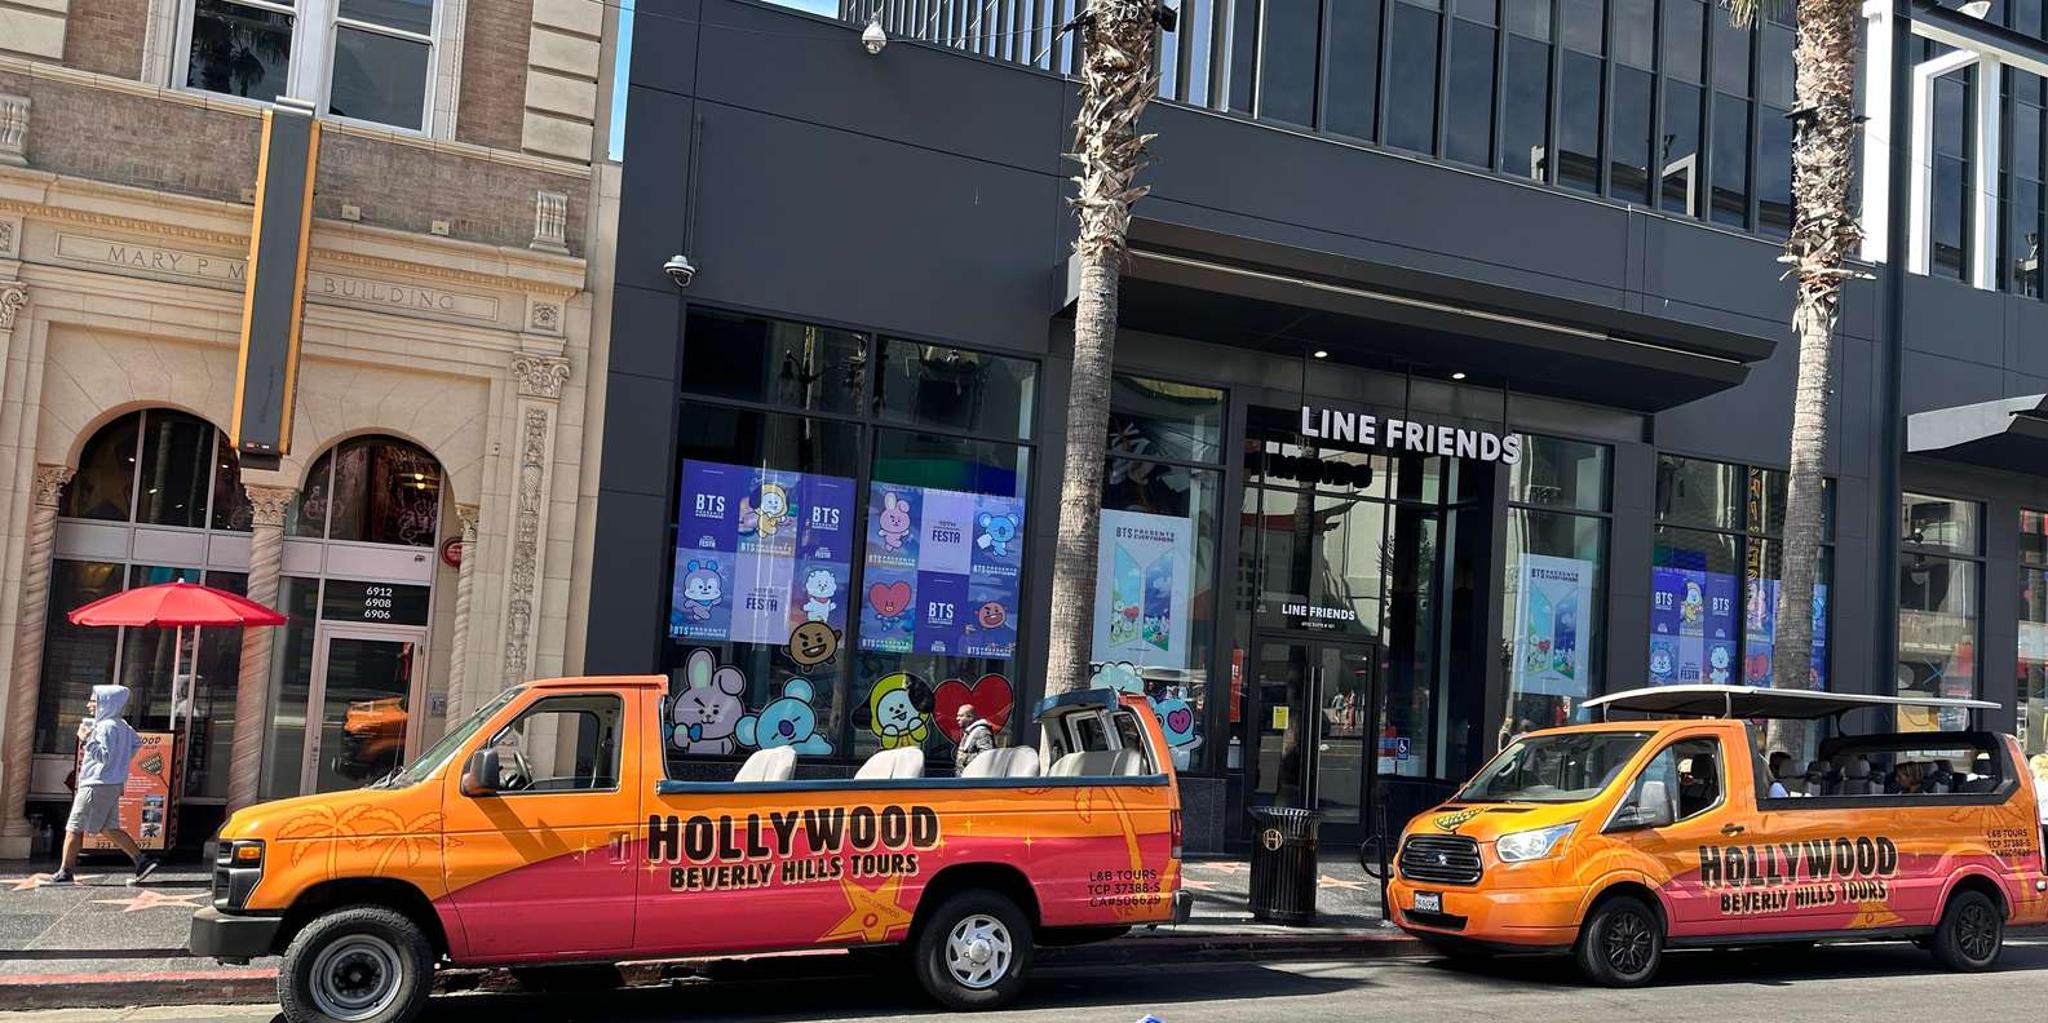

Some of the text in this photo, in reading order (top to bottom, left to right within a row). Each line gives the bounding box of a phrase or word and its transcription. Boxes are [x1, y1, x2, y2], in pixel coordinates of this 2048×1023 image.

[107, 245, 183, 271] MARY
[196, 258, 209, 275] P
[324, 277, 455, 310] BUILDING
[1302, 406, 1522, 465] LINE FRIENDS
[696, 494, 725, 512] BTS
[812, 506, 840, 524] BTS
[932, 529, 961, 544] FESTA
[1116, 527, 1133, 538] BTS
[366, 586, 393, 597] 6912
[1655, 592, 1673, 605] BTS
[365, 598, 392, 608] 6908
[746, 597, 777, 612] FESTA
[928, 602, 954, 619] BTS
[1712, 597, 1730, 611] BTS
[364, 609, 391, 620] 6906
[1282, 604, 1355, 620] LINE FRIENDS
[647, 804, 941, 865] HOLLYWOOD
[1698, 836, 1899, 888] HOLLYWOOD
[670, 852, 919, 891] BEVERLY HILLS TOURS
[1089, 868, 1157, 882] L&B TOURS
[1088, 881, 1161, 895] TCP 37388-S
[1720, 879, 1889, 915] BEVERLY HILLS TOURS
